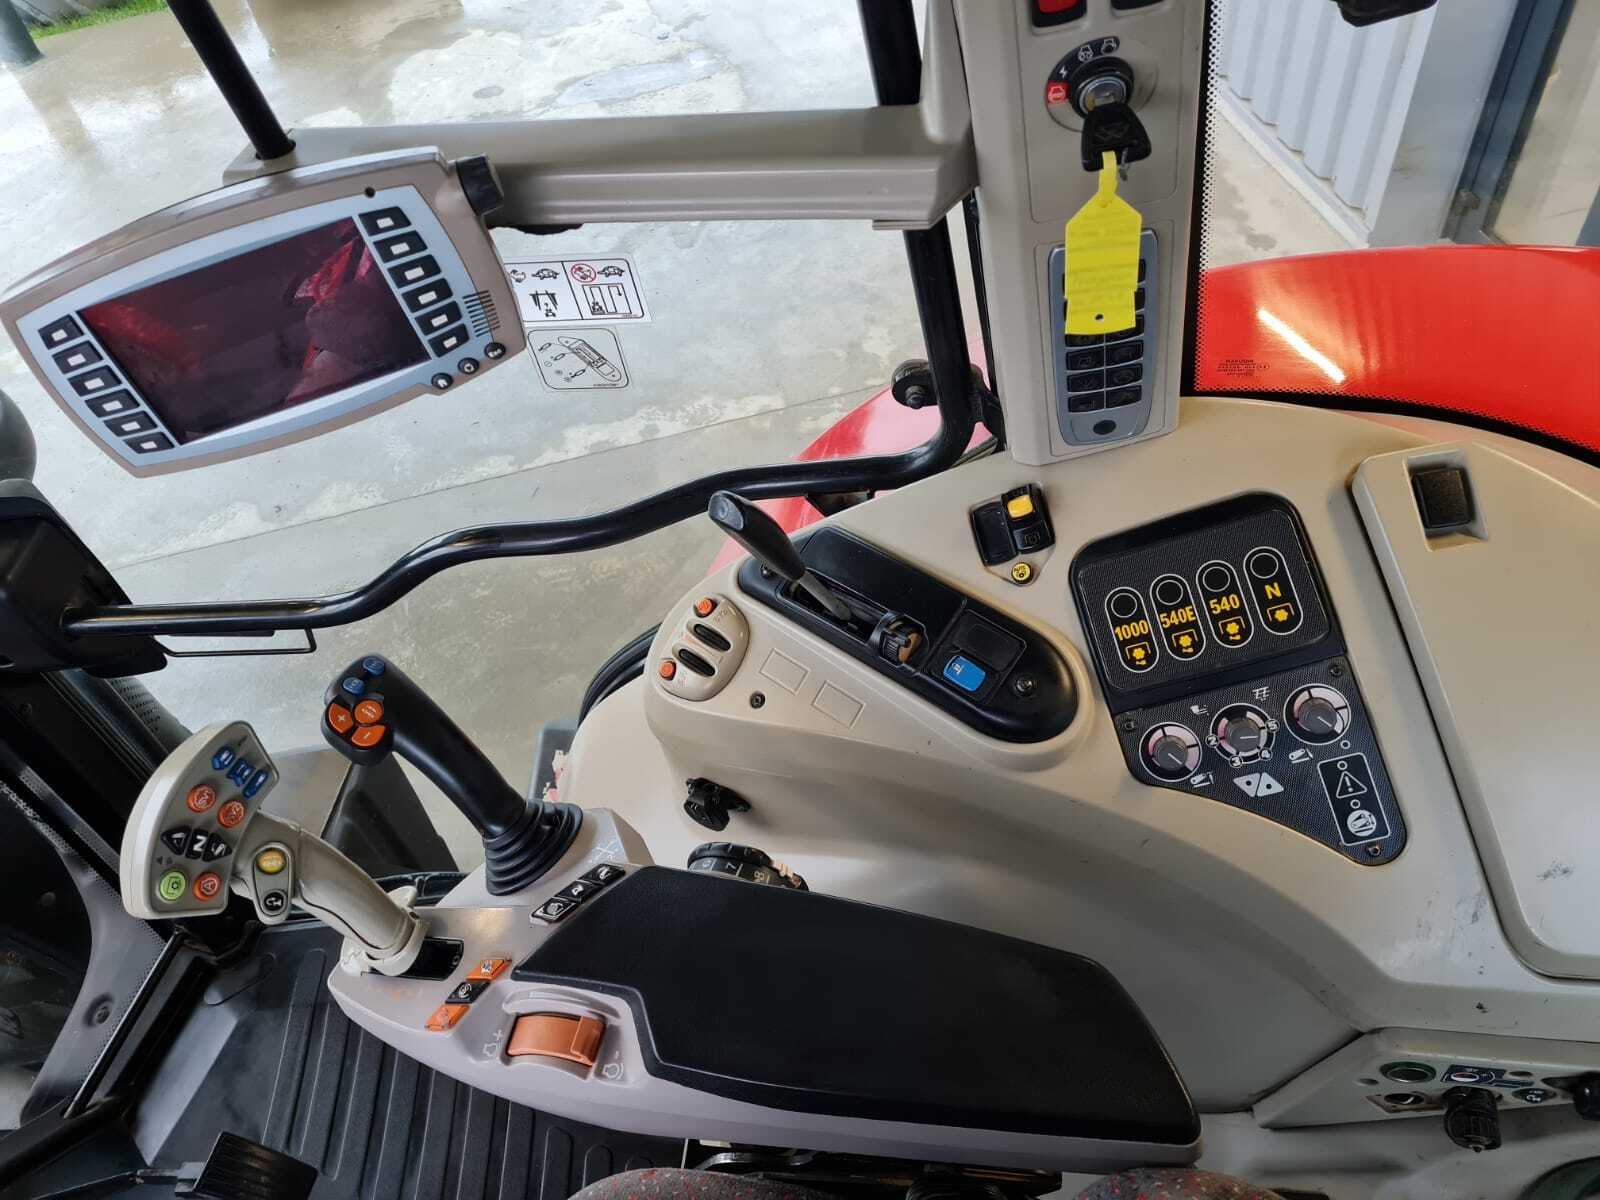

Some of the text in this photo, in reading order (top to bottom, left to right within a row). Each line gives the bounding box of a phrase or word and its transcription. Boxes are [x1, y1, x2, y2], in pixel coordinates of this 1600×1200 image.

[1264, 582, 1282, 600] N
[1209, 594, 1240, 615] 540
[1160, 605, 1196, 629] 540E
[1114, 619, 1149, 642] 1000
[1267, 720, 1278, 730] 5
[1207, 736, 1217, 746] 2
